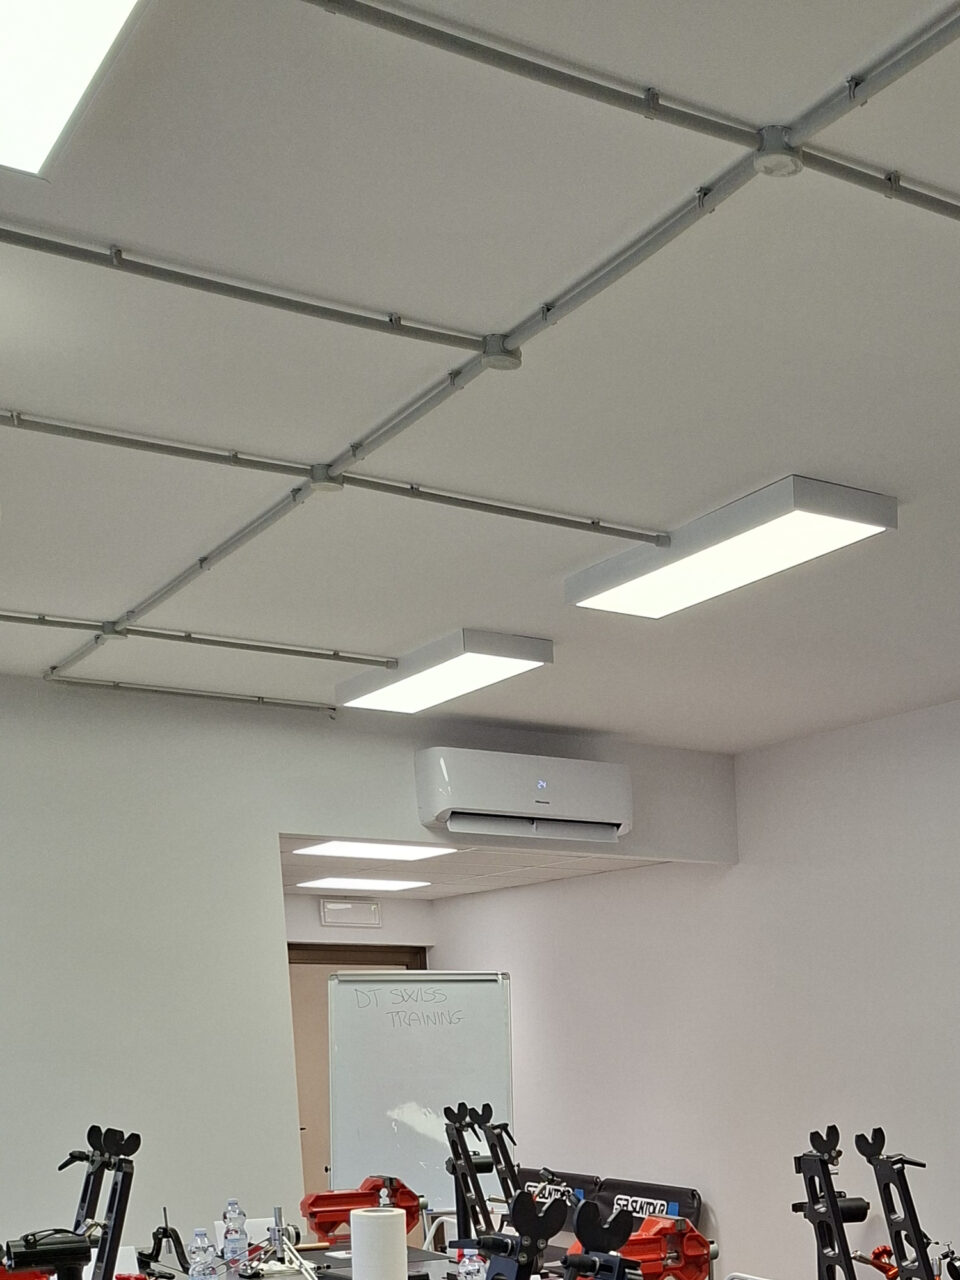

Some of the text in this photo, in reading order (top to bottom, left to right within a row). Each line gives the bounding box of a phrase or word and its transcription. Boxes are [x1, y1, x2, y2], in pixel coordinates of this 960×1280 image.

[353, 988, 448, 1009] DT SWISS
[385, 1009, 465, 1028] TRAINING
